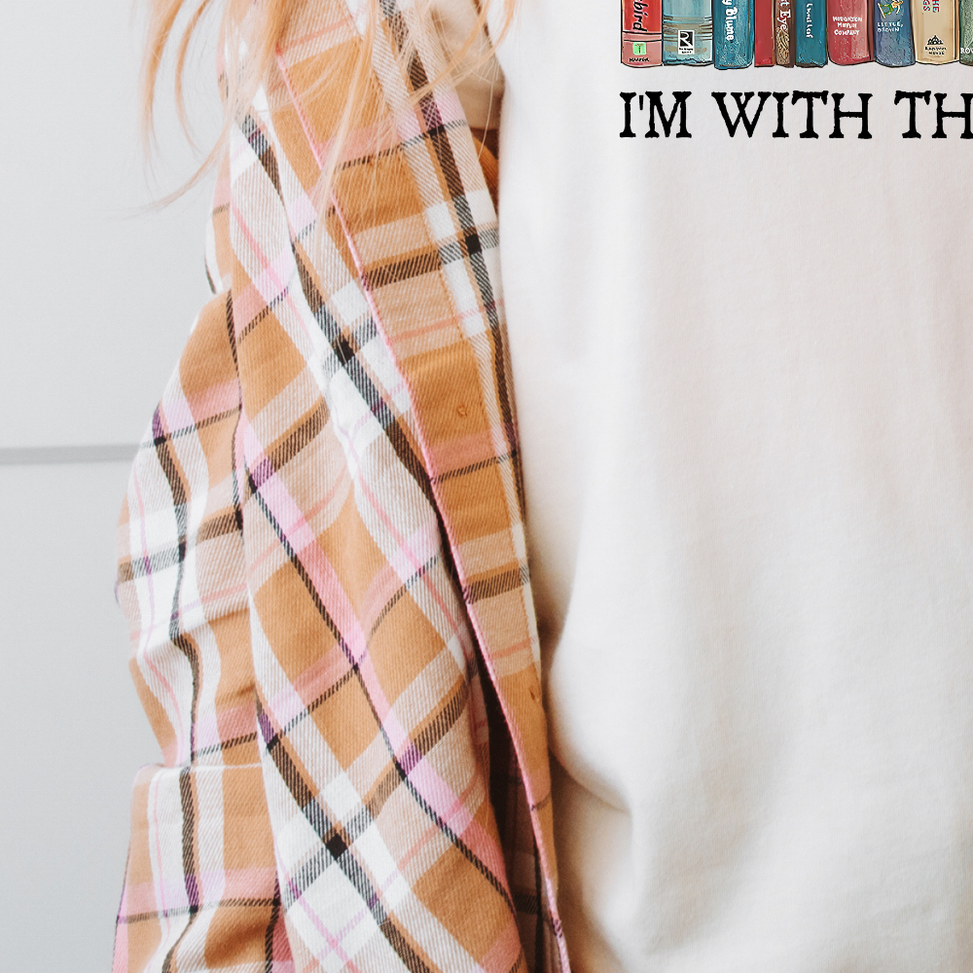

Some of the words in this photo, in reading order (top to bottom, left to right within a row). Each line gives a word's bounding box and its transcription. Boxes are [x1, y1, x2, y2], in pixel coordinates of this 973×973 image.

[725, 7, 738, 42] Blume
[777, 8, 791, 31] Eye
[620, 91, 692, 138] I'M
[712, 91, 873, 139] WITH
